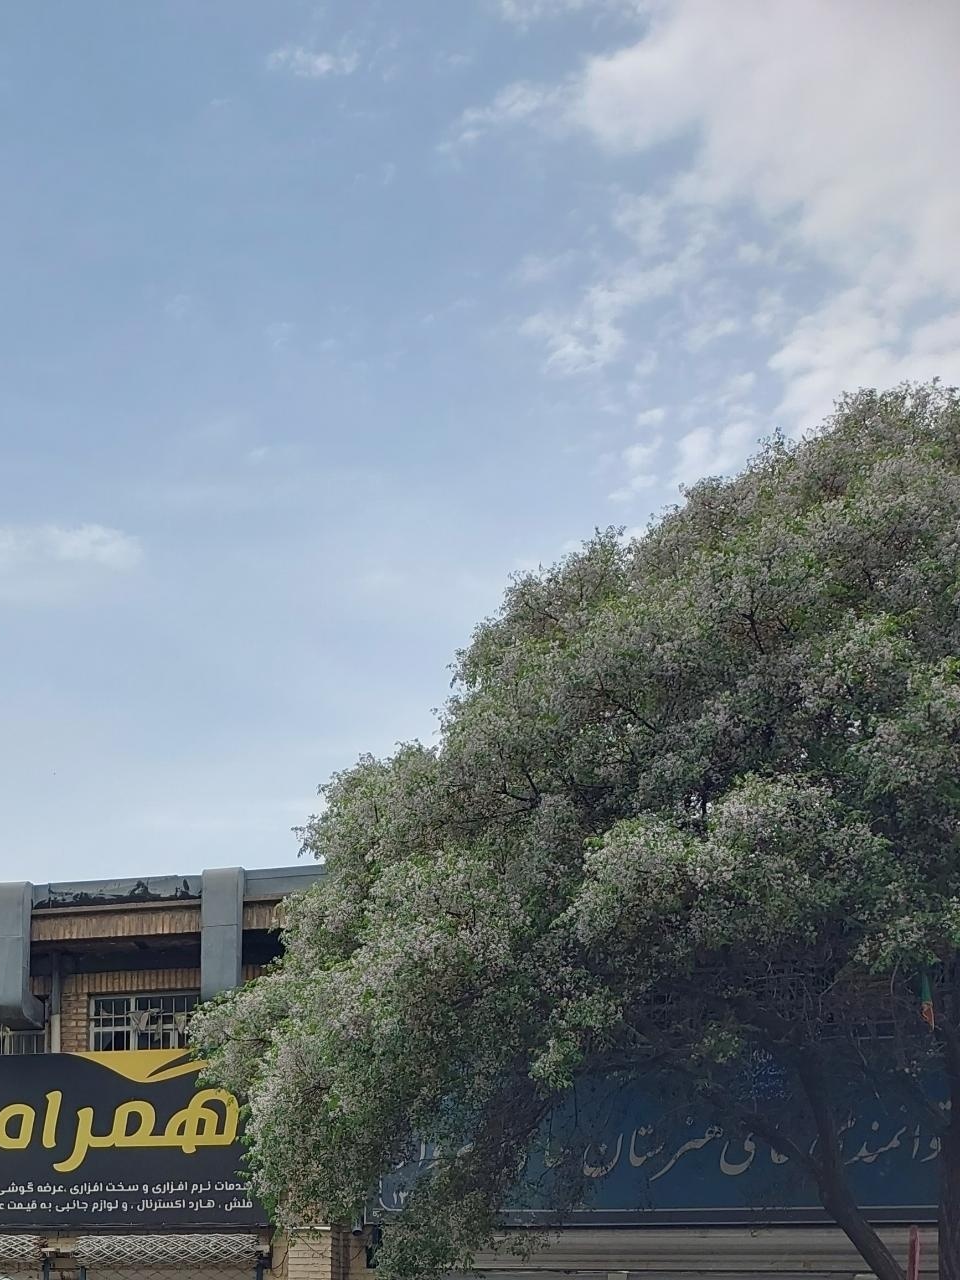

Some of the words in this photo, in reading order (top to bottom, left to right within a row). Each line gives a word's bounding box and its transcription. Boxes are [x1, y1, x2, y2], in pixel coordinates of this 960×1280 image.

[69, 1183, 103, 1195] افزاری
[105, 1182, 139, 1192] سخت
[142, 1184, 149, 1194] و
[151, 1181, 188, 1194] افزاری
[190, 1181, 211, 1194] نرم
[7, 1200, 38, 1212] قیمت
[40, 1202, 52, 1212] به
[55, 1200, 89, 1212] جانبی
[91, 1200, 119, 1212] لوازم
[121, 1202, 128, 1212] و
[136, 1199, 186, 1212] اکسترنال
[188, 1199, 215, 1211] هارد
[224, 1197, 253, 1212] فلش
